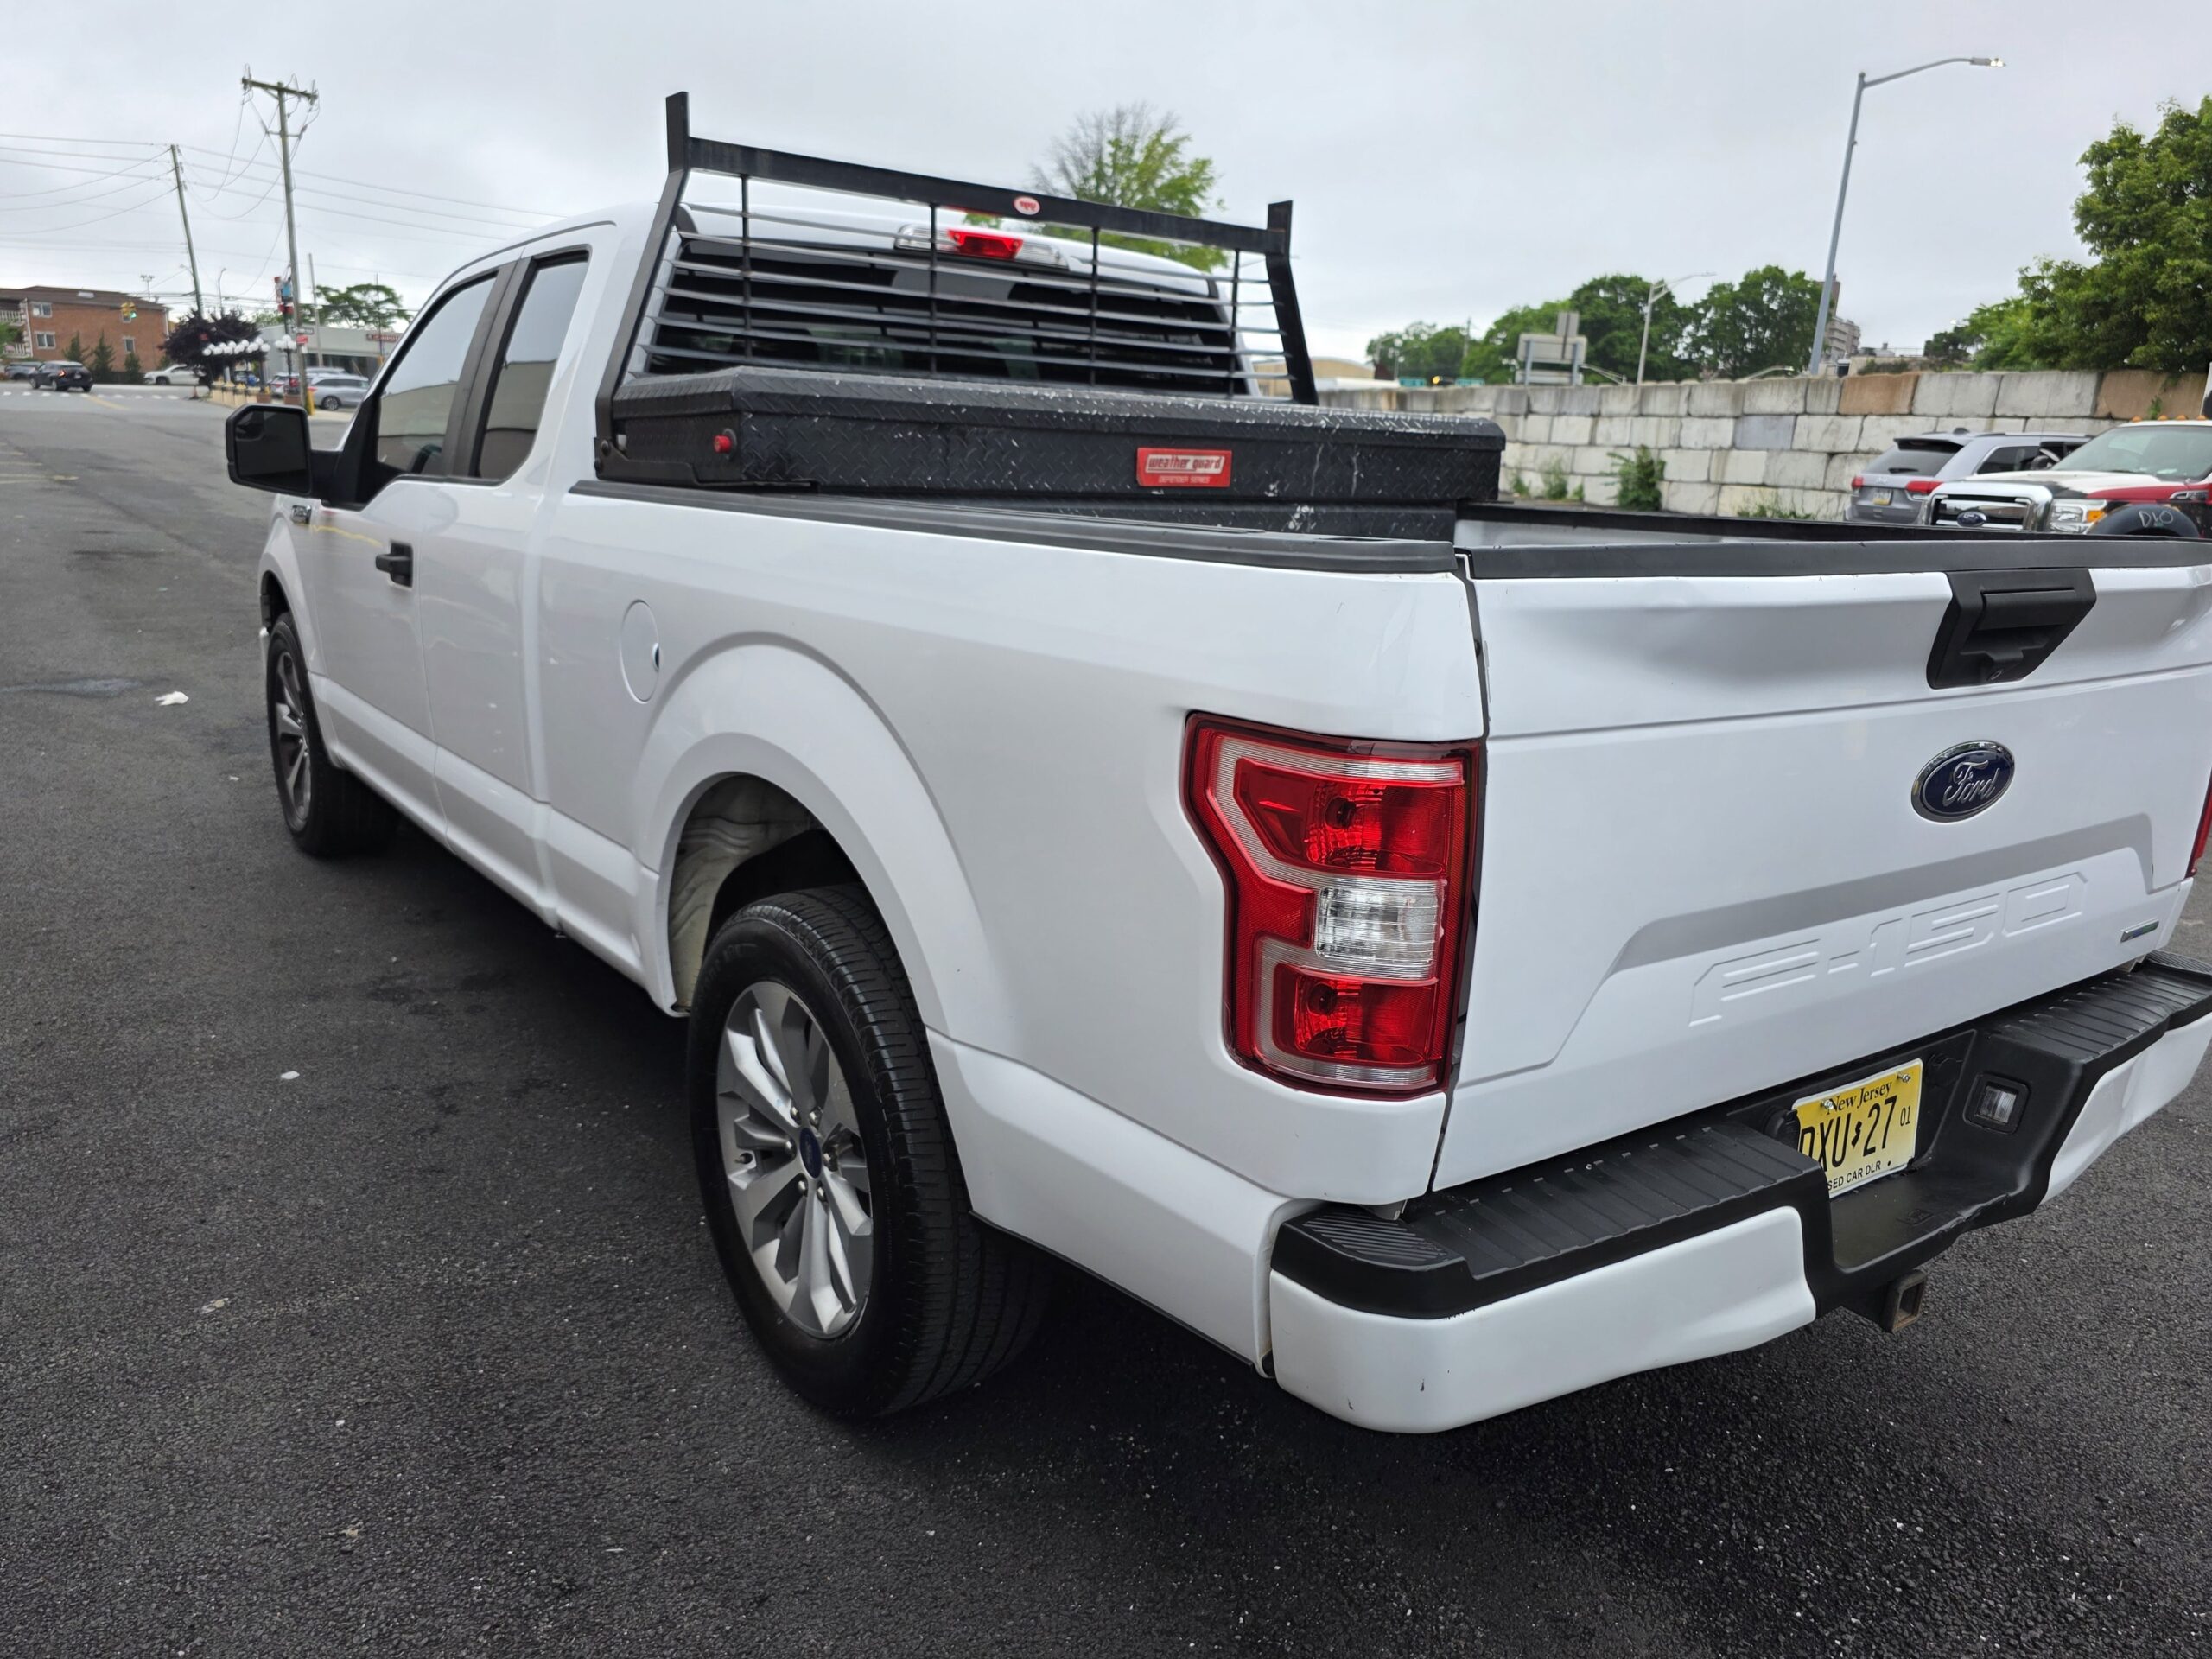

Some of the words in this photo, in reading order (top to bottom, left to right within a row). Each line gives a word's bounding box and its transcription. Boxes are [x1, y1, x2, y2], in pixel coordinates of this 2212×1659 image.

[1147, 454, 1191, 469] weather
[1192, 455, 1224, 471] guard
[1942, 760, 2000, 807] Ford
[1688, 871, 2088, 1027] F-150
[1826, 1096, 1857, 1116] New
[1856, 1081, 1893, 1109] Jersey
[1900, 1105, 1911, 1127] 01
[1827, 1175, 1844, 1191] SED
[1846, 1166, 1863, 1184] CAR
[1866, 1160, 1881, 1177] DLR
